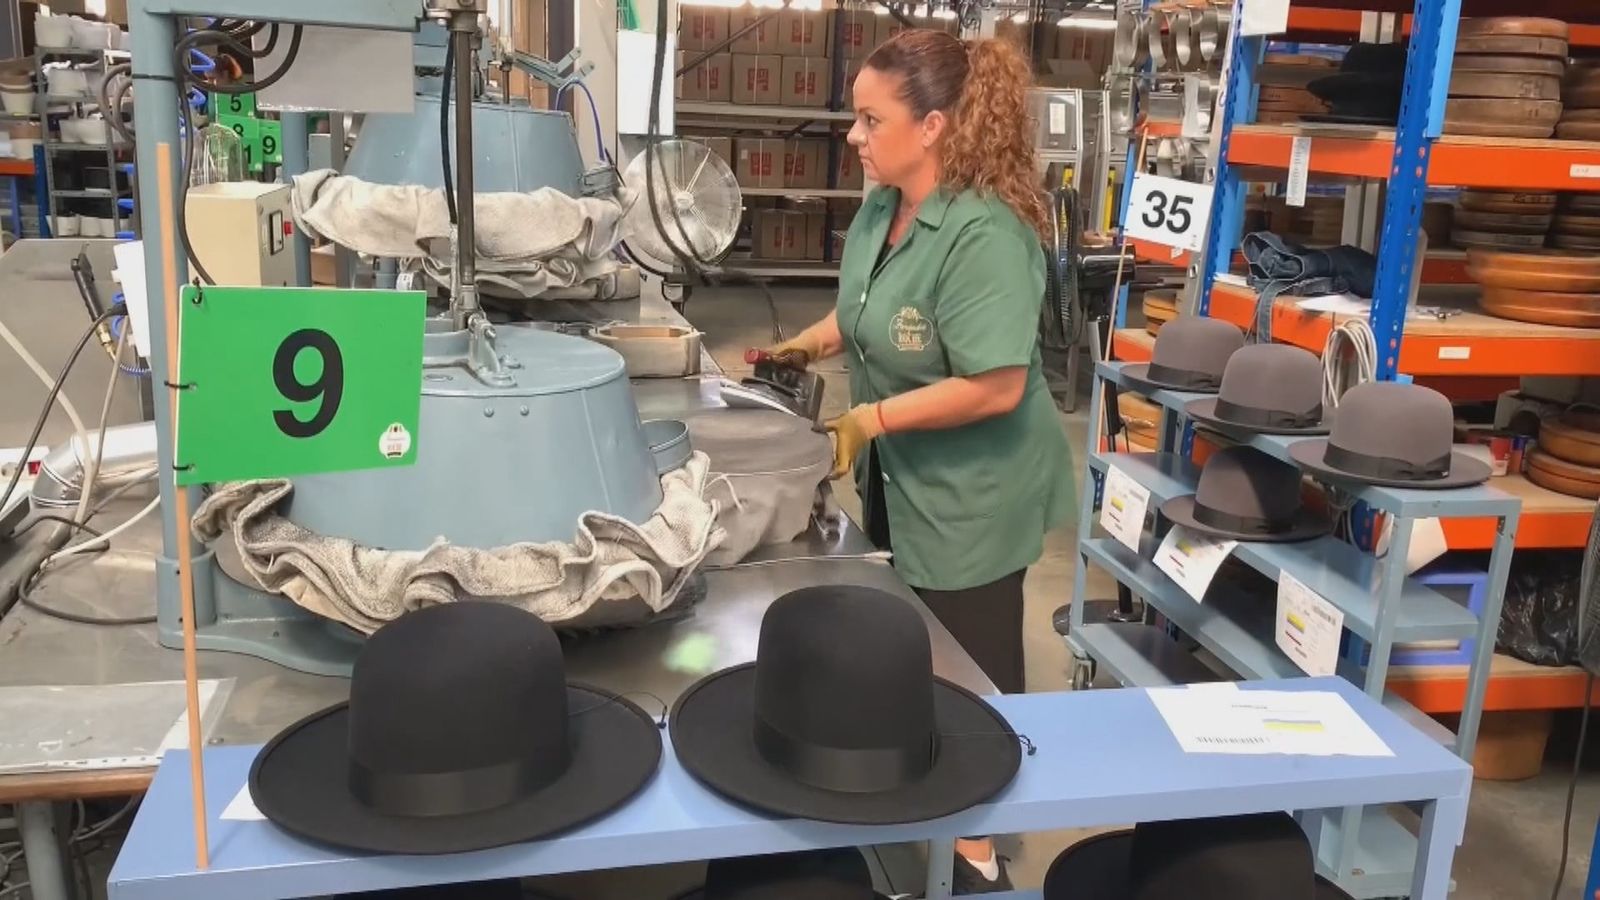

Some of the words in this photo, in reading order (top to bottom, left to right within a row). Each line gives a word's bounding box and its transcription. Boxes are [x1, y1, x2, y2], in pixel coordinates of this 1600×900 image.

[230, 93, 242, 112] 5
[262, 135, 276, 155] 9
[1142, 190, 1194, 234] 35
[272, 328, 344, 438] 9
